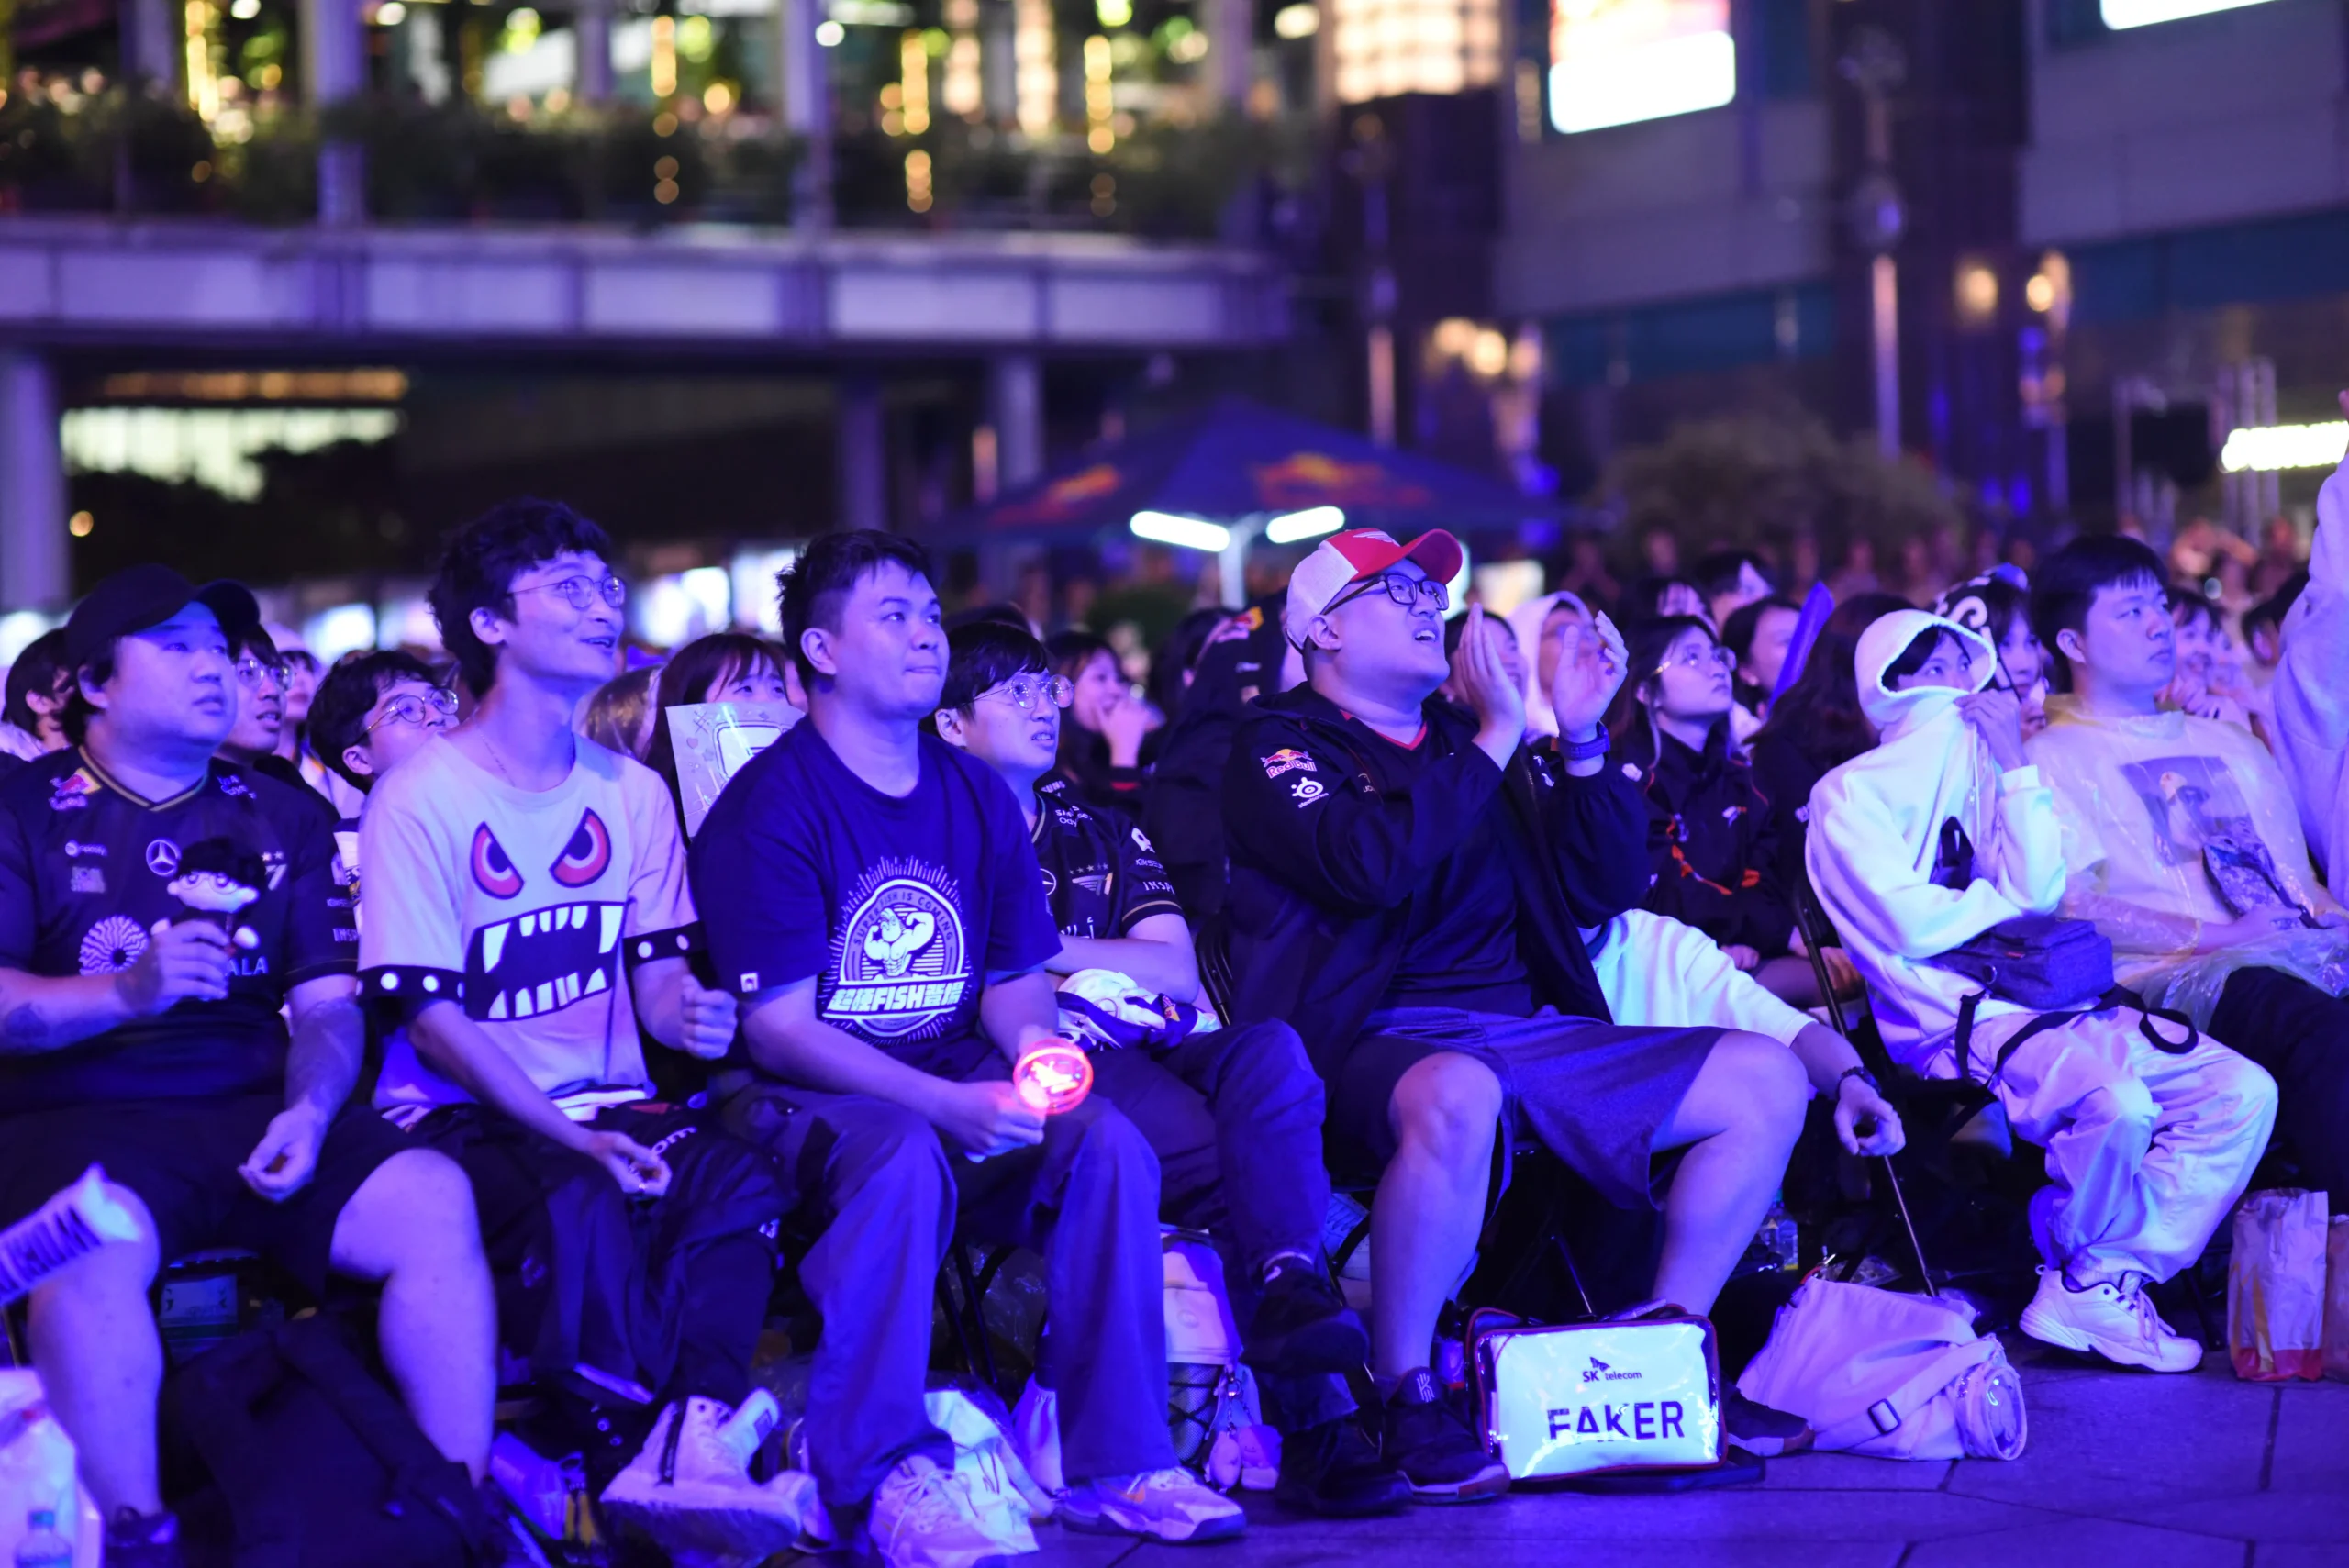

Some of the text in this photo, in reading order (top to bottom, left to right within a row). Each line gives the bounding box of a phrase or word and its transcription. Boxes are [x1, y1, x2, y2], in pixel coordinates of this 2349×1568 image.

[1266, 759, 1318, 779] Red Bull
[853, 891, 954, 946] SUPER FISH IS COMING
[1582, 1370, 1642, 1383] SK telecom
[1546, 1400, 1686, 1440] FAKER
